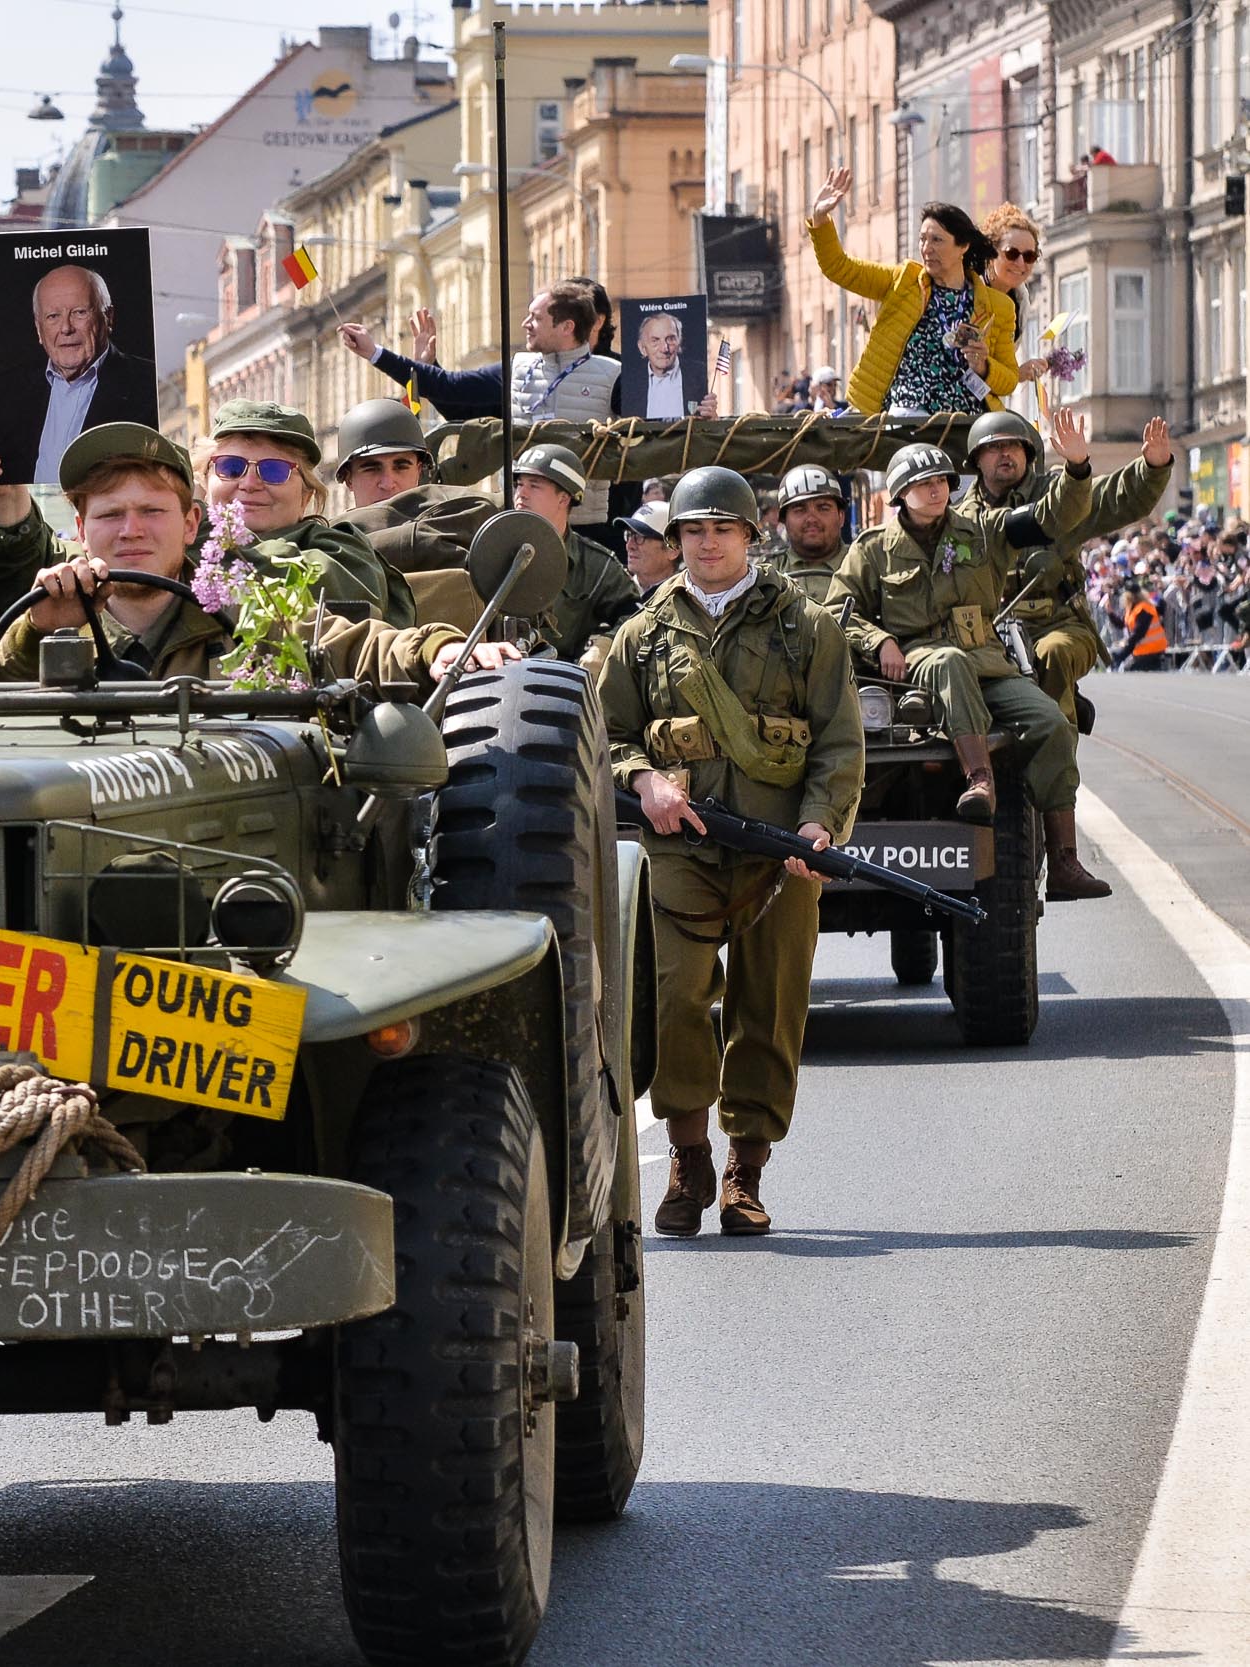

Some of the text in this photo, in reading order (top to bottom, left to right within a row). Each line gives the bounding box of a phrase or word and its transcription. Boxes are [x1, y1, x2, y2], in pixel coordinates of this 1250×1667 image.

[14, 244, 108, 260] Michel Gilain
[663, 302, 688, 311] Gustin
[913, 449, 943, 469] MP
[785, 469, 827, 498] MP
[202, 738, 278, 784] USA
[883, 846, 969, 868] POLICE
[116, 1030, 276, 1109] DRIVER
